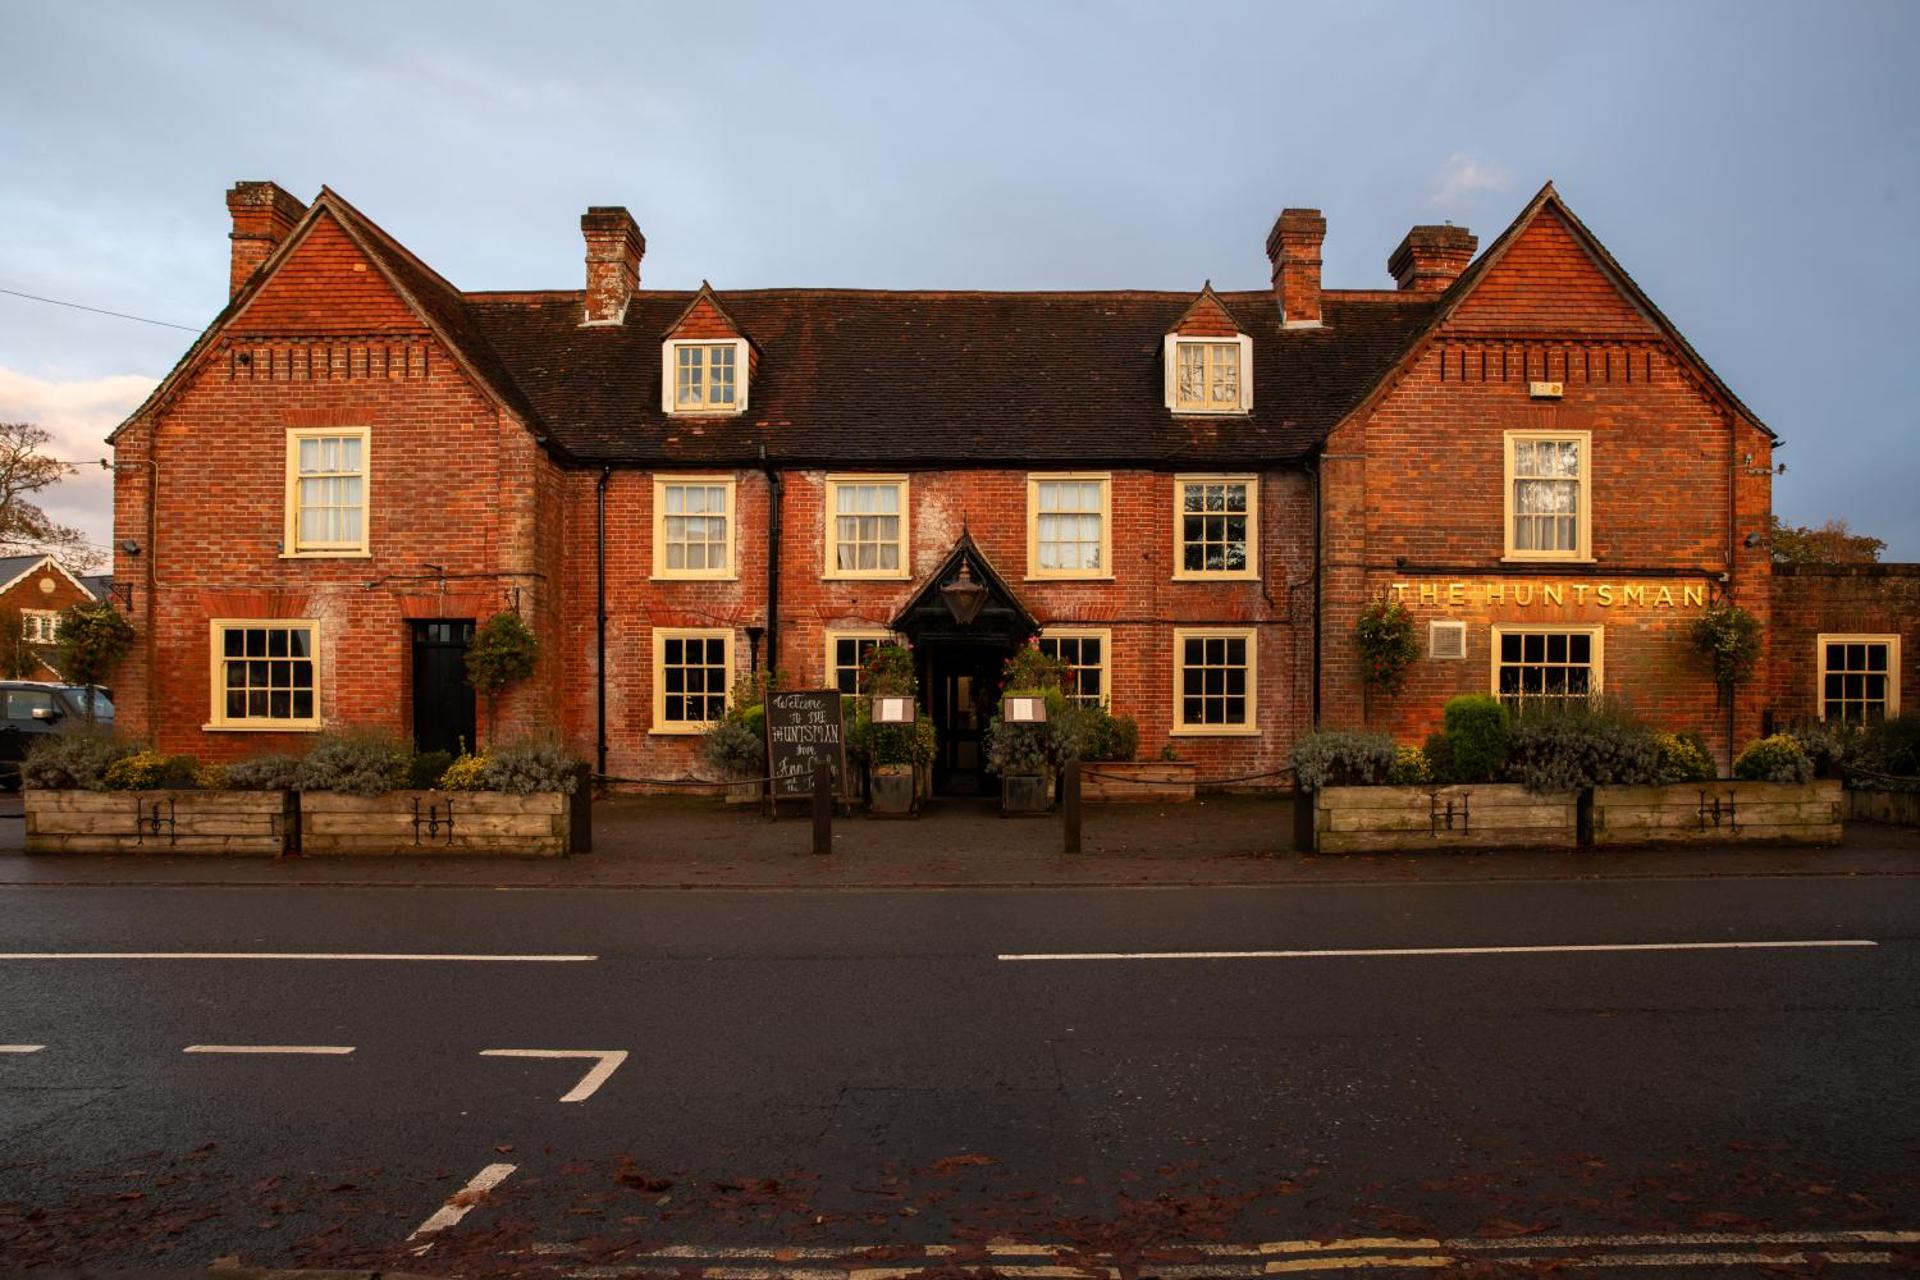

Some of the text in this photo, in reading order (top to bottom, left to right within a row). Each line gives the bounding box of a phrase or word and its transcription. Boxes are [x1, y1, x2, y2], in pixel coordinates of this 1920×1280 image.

[1391, 583, 1704, 607] THE HUNTSMAN
[771, 723, 839, 743] HUNTSMAN
